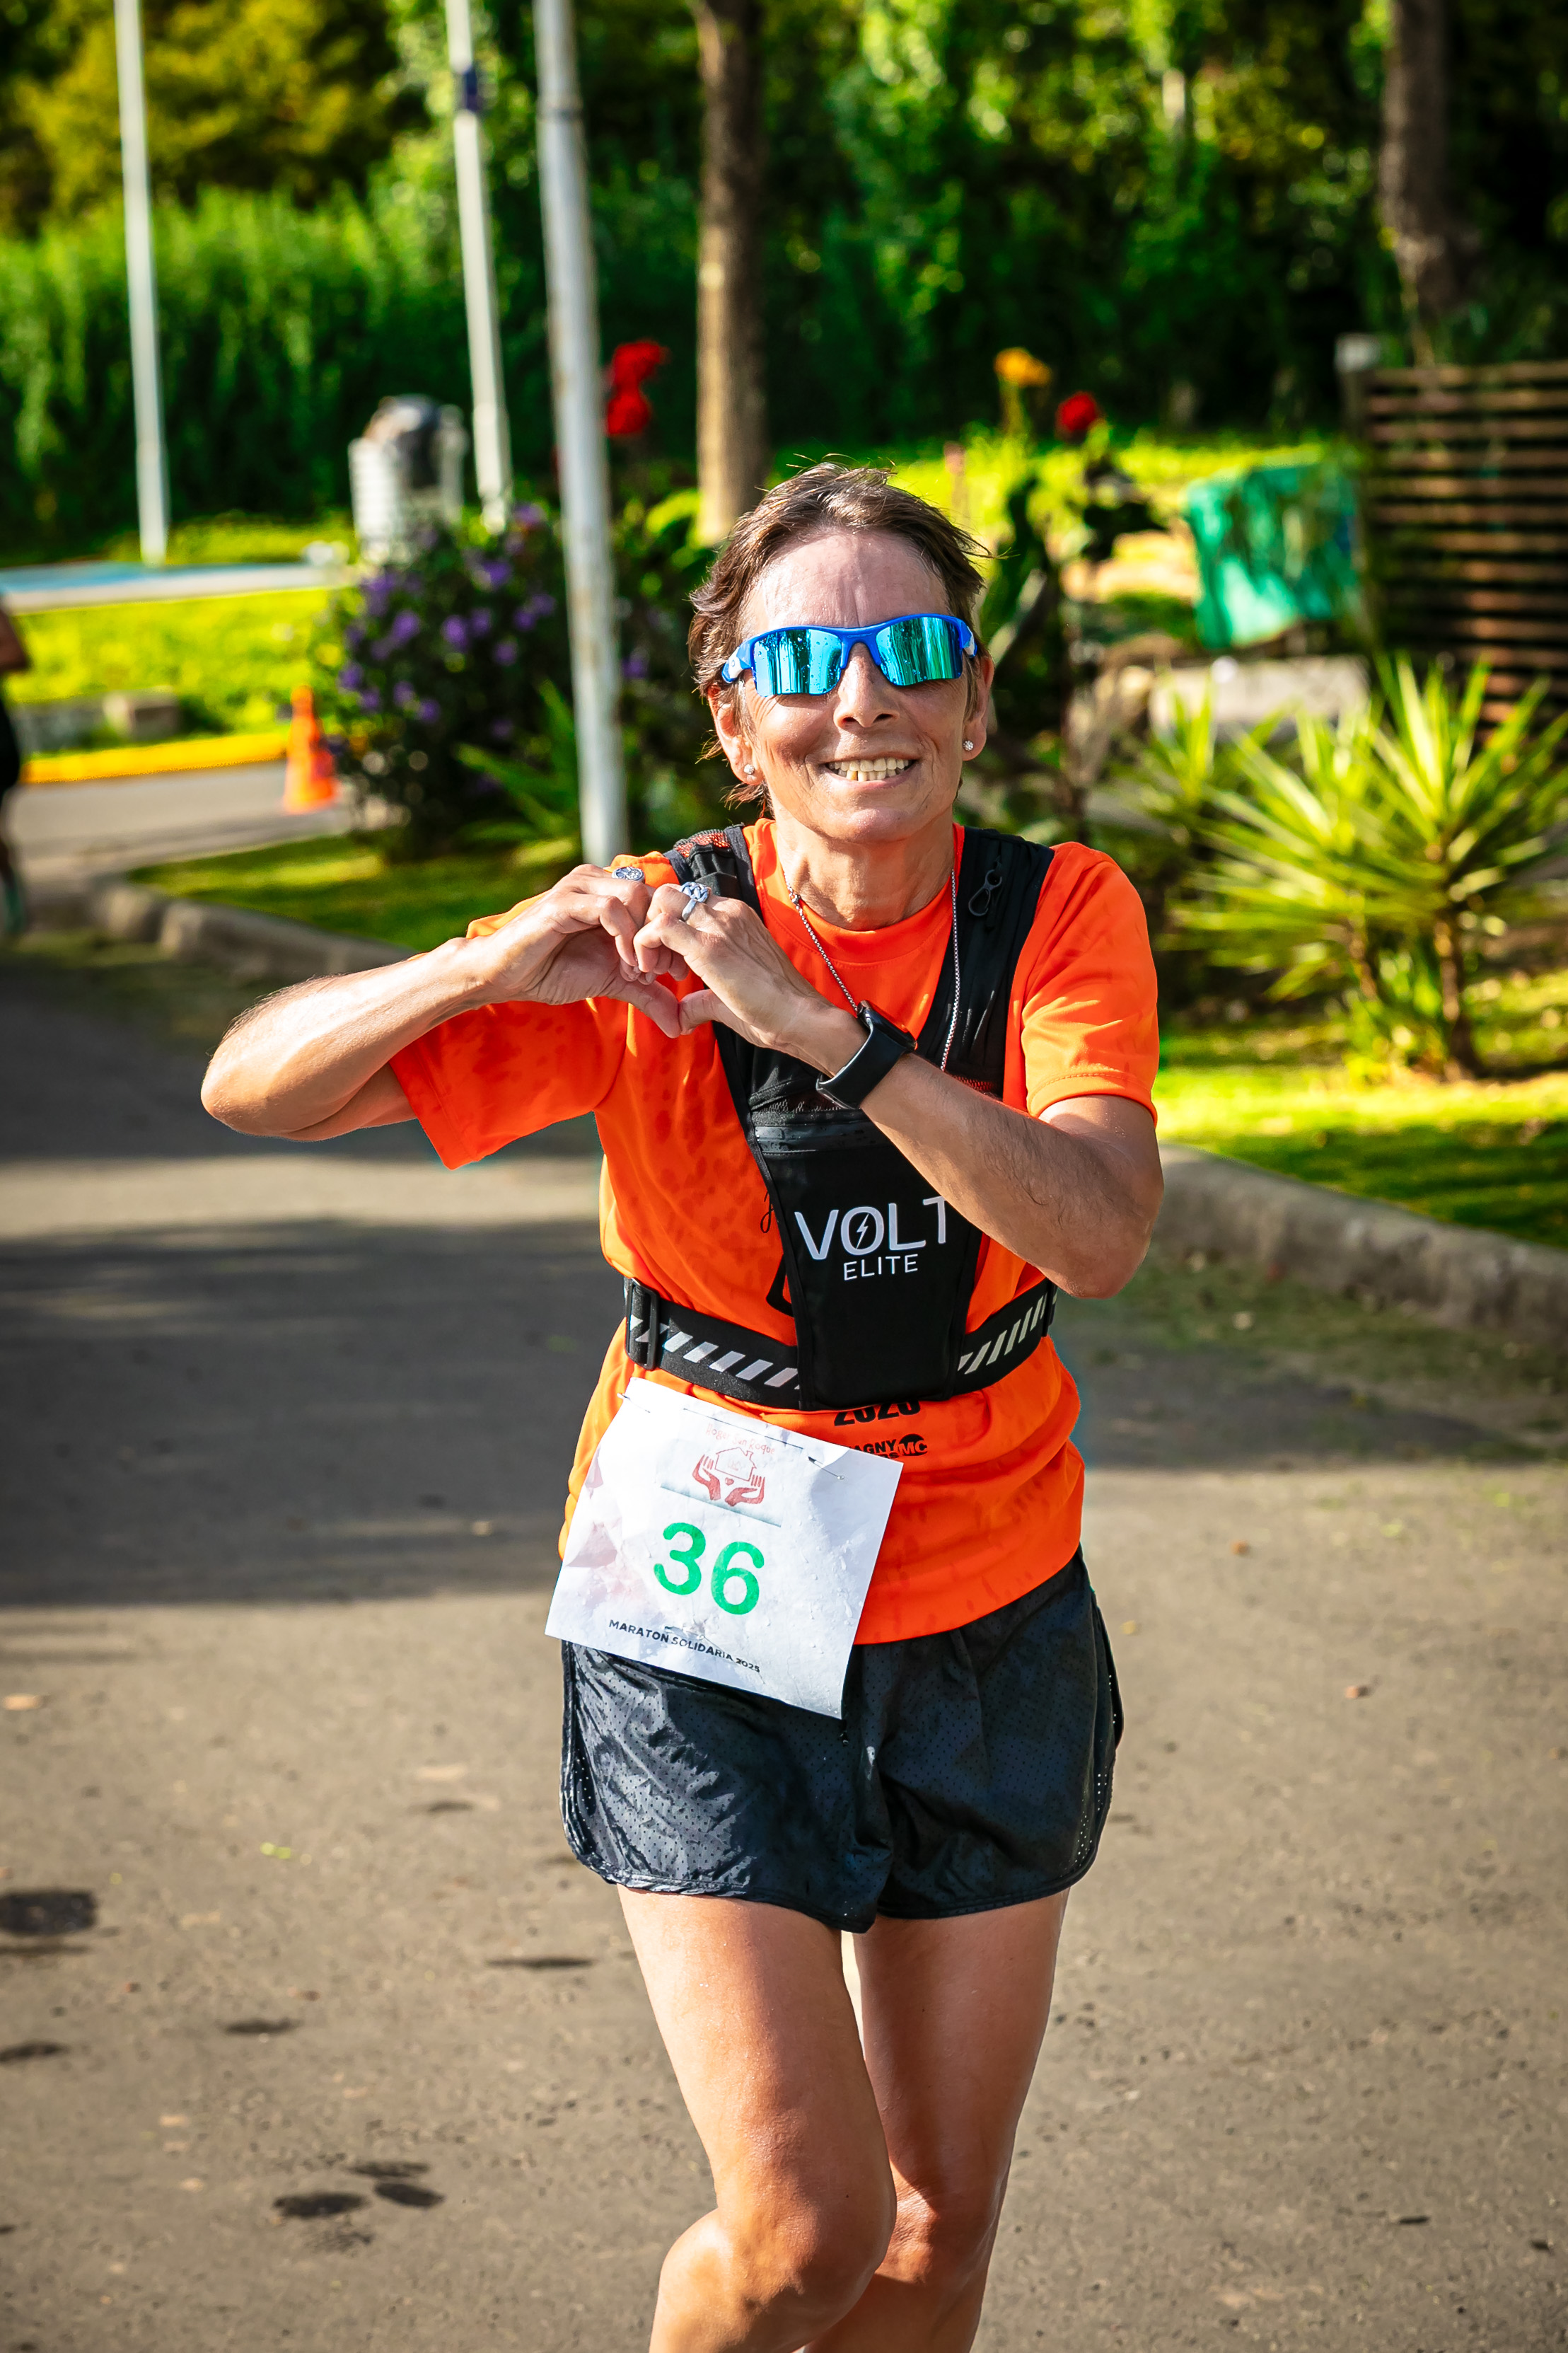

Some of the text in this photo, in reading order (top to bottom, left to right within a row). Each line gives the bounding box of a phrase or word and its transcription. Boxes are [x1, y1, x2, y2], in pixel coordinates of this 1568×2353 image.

[794, 1196, 947, 1260] VOLT
[844, 1254, 918, 1280] ELITE
[654, 1522, 765, 1615] 36
[609, 1619, 761, 1673] MARATON SOLIDARIA 2025
